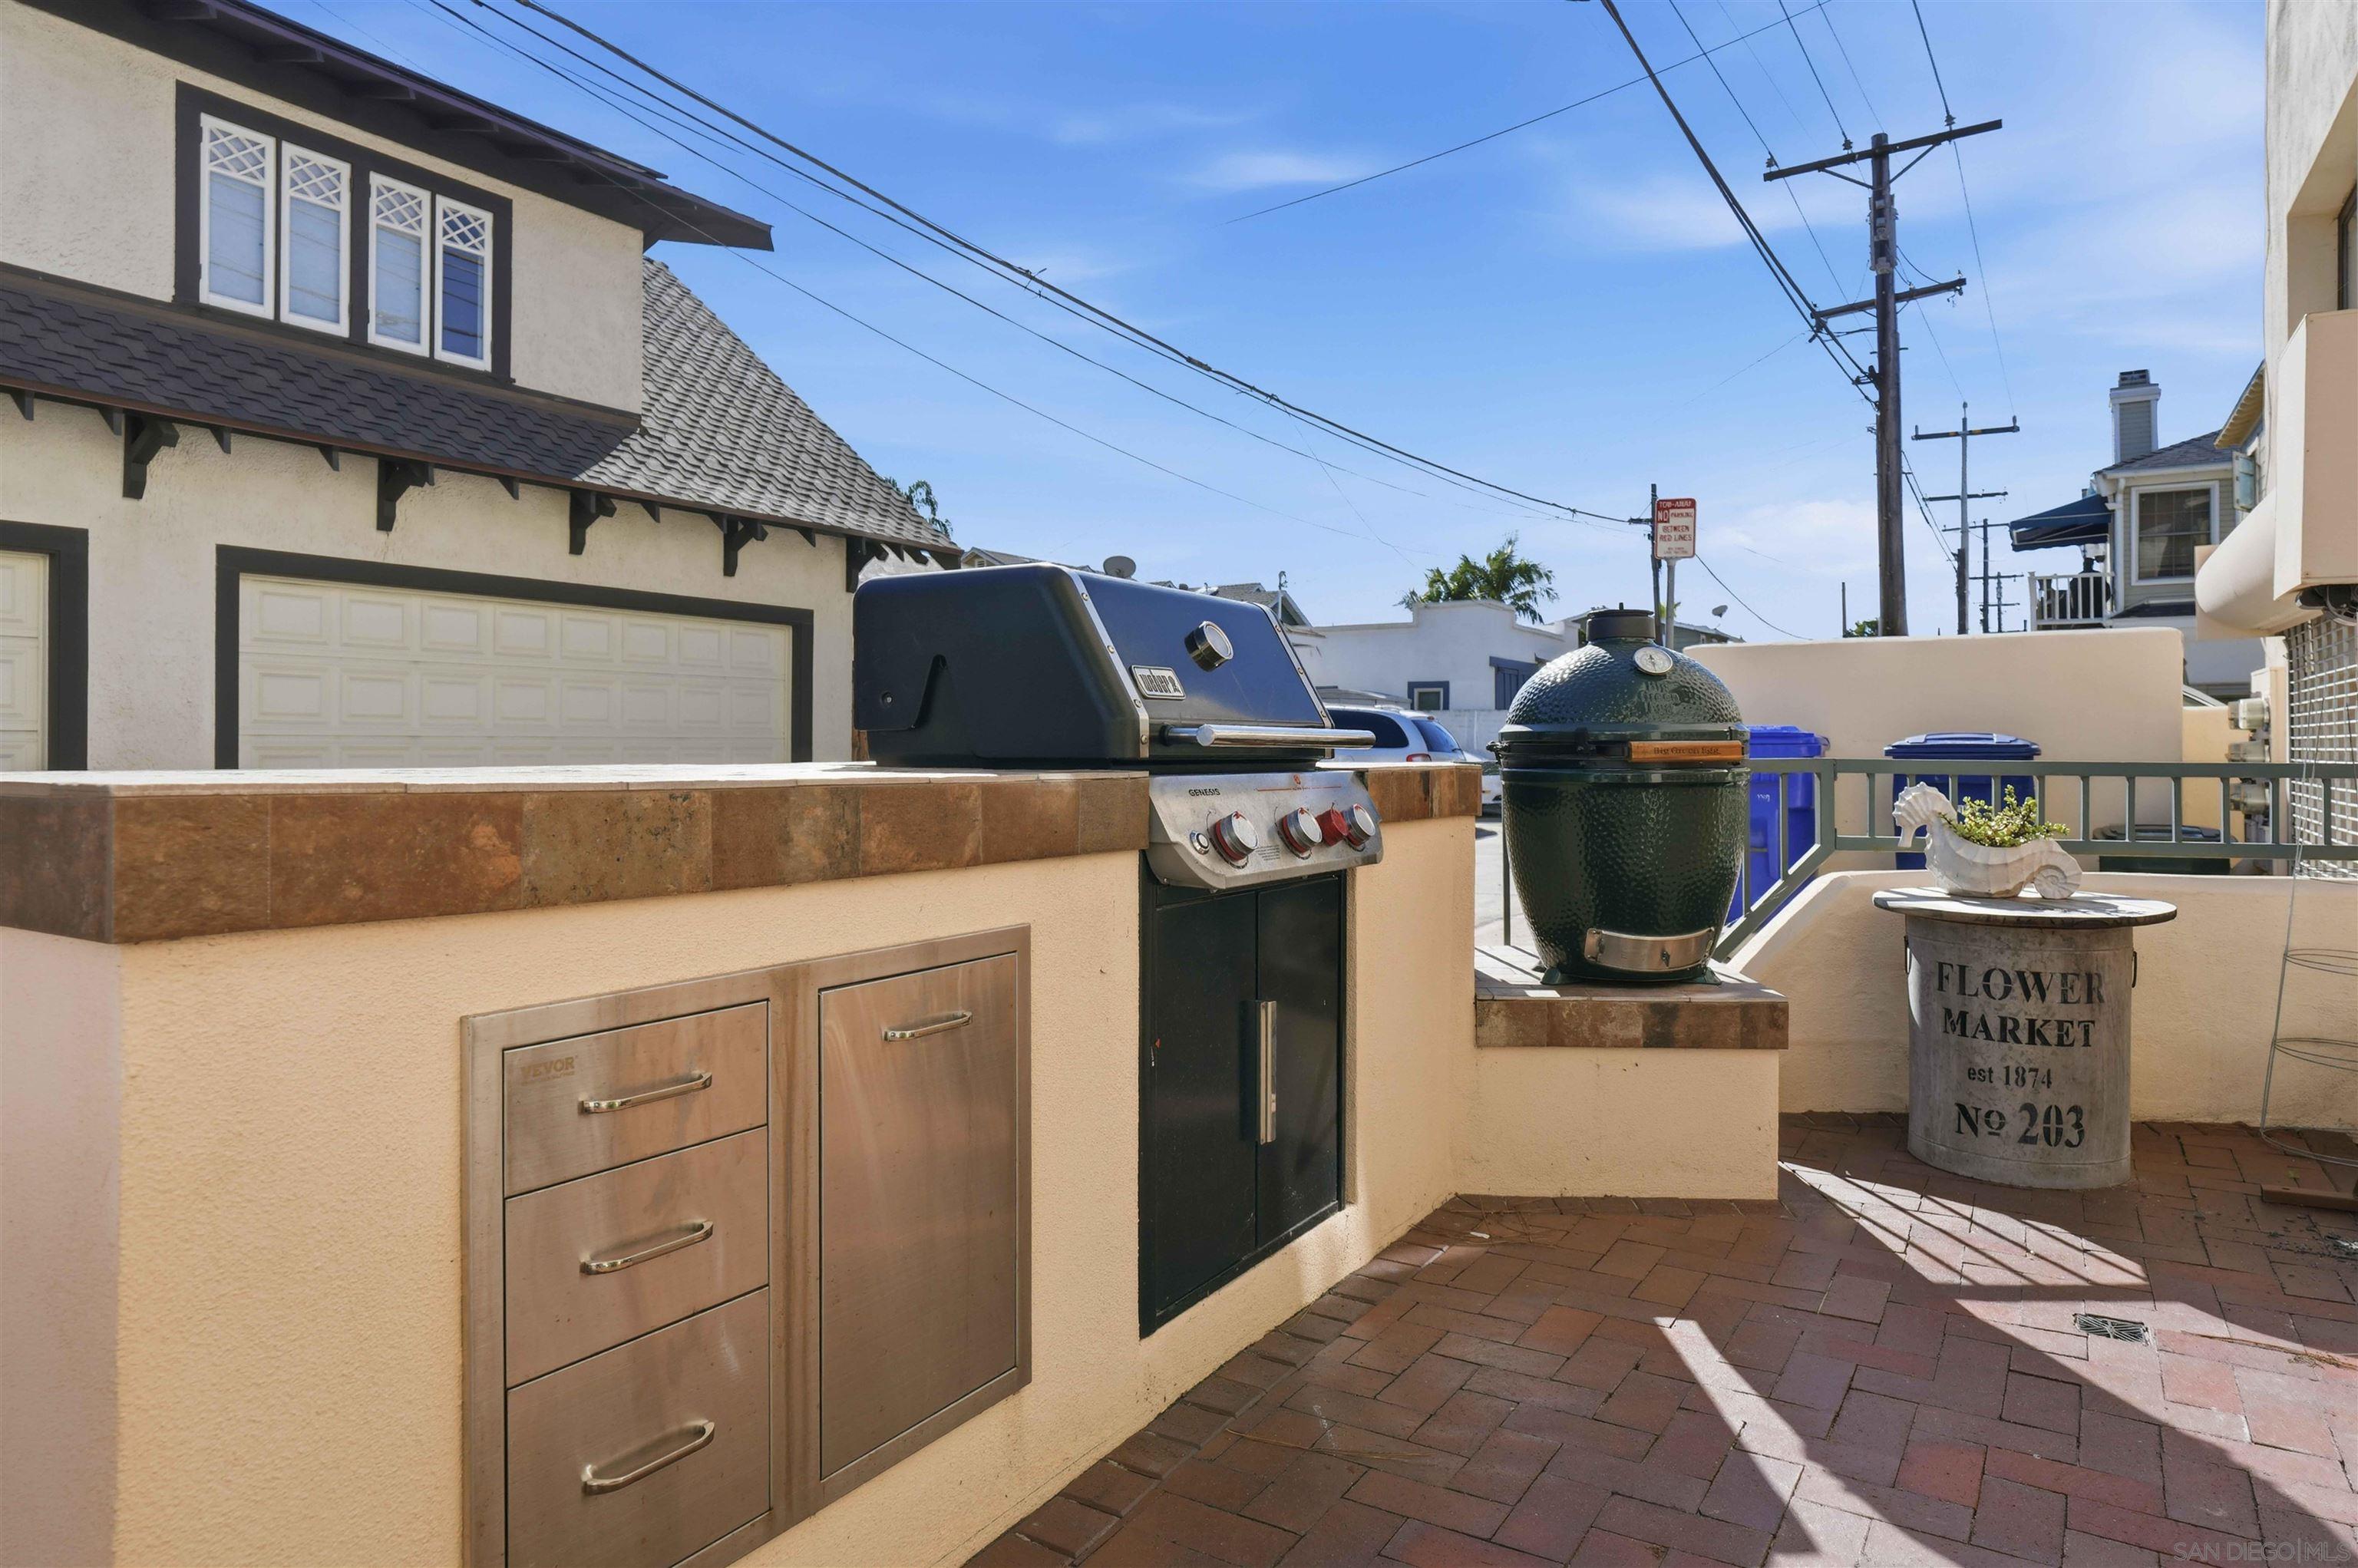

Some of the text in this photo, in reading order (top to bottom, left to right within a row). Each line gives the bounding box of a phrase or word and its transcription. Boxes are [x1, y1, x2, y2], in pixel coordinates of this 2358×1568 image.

[1658, 510, 1669, 522] NO
[1653, 747, 1669, 755] Big
[1188, 787, 1221, 797] GENESIS
[1937, 961, 2105, 1005] FLOWER
[1942, 1007, 2095, 1048] MARKET
[520, 1056, 575, 1079] VEVOR
[1967, 1065, 2053, 1089] est 1874
[2017, 1102, 2086, 1148] 203
